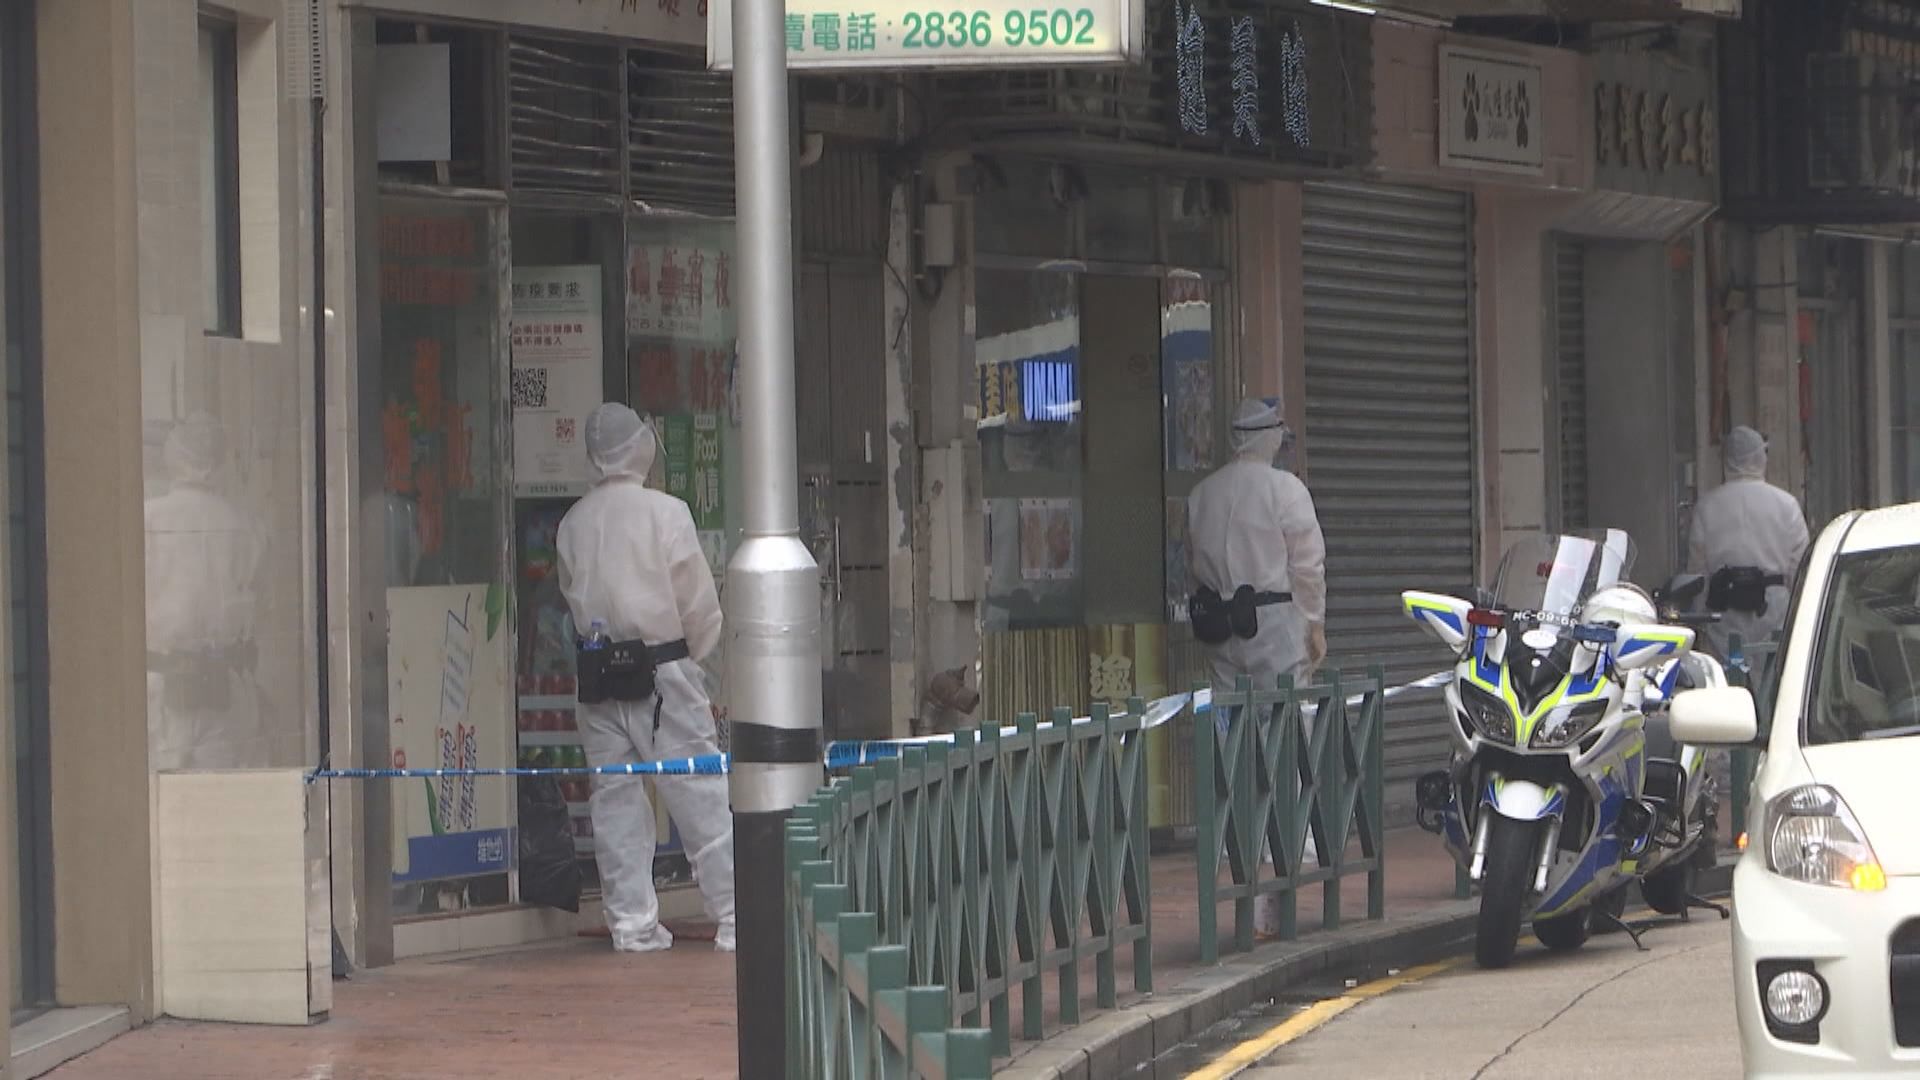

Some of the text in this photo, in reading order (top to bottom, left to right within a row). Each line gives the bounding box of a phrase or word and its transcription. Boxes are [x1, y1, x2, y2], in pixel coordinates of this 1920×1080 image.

[902, 11, 991, 48] 2836
[1005, 9, 1096, 47] 9502
[1023, 361, 1073, 422] UMAMI
